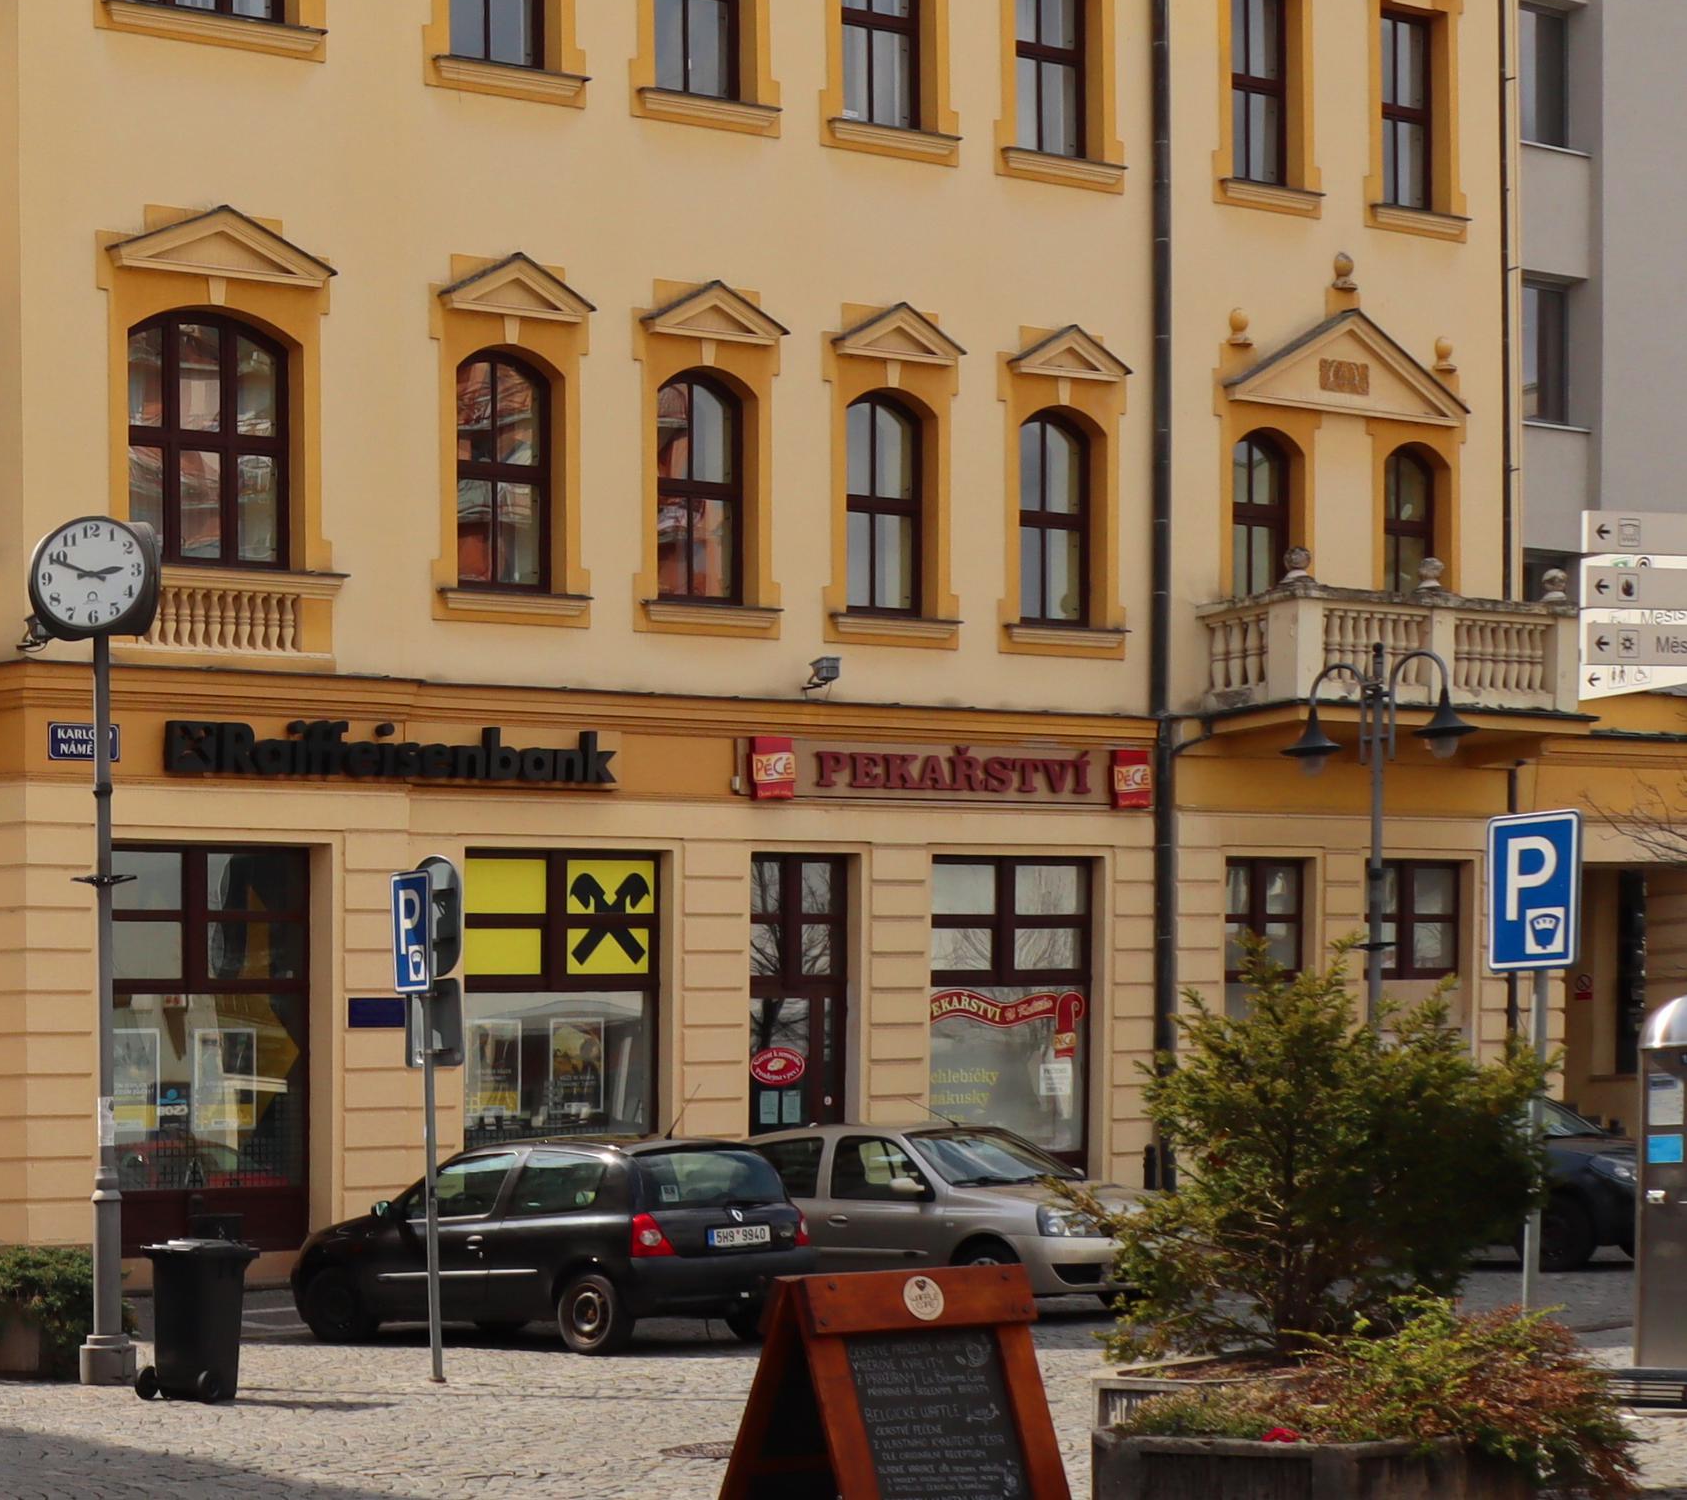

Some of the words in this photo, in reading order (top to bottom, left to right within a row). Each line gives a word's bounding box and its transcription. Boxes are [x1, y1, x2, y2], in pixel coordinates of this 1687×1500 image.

[83, 523, 100, 539] 12
[109, 527, 115, 541] 1
[63, 532, 76, 547] 11
[122, 541, 133, 555] 2
[49, 550, 67, 565] 10
[131, 562, 142, 577] 3
[42, 572, 52, 586] 9
[124, 584, 134, 598] 4
[49, 592, 61, 607] 8
[66, 606, 75, 621] 7
[88, 609, 99, 624] 6
[110, 602, 121, 616] 5
[57, 728, 113, 740] KARLO
[221, 719, 618, 785] Raiffeisenbank
[816, 745, 1092, 794] PEKAŘSTVÍ
[1506, 835, 1557, 921] P
[399, 888, 420, 954] P
[931, 993, 1002, 1022] EKAŘSTVÍ
[716, 1231, 734, 1243] 5H9
[742, 1228, 766, 1241] 9940
